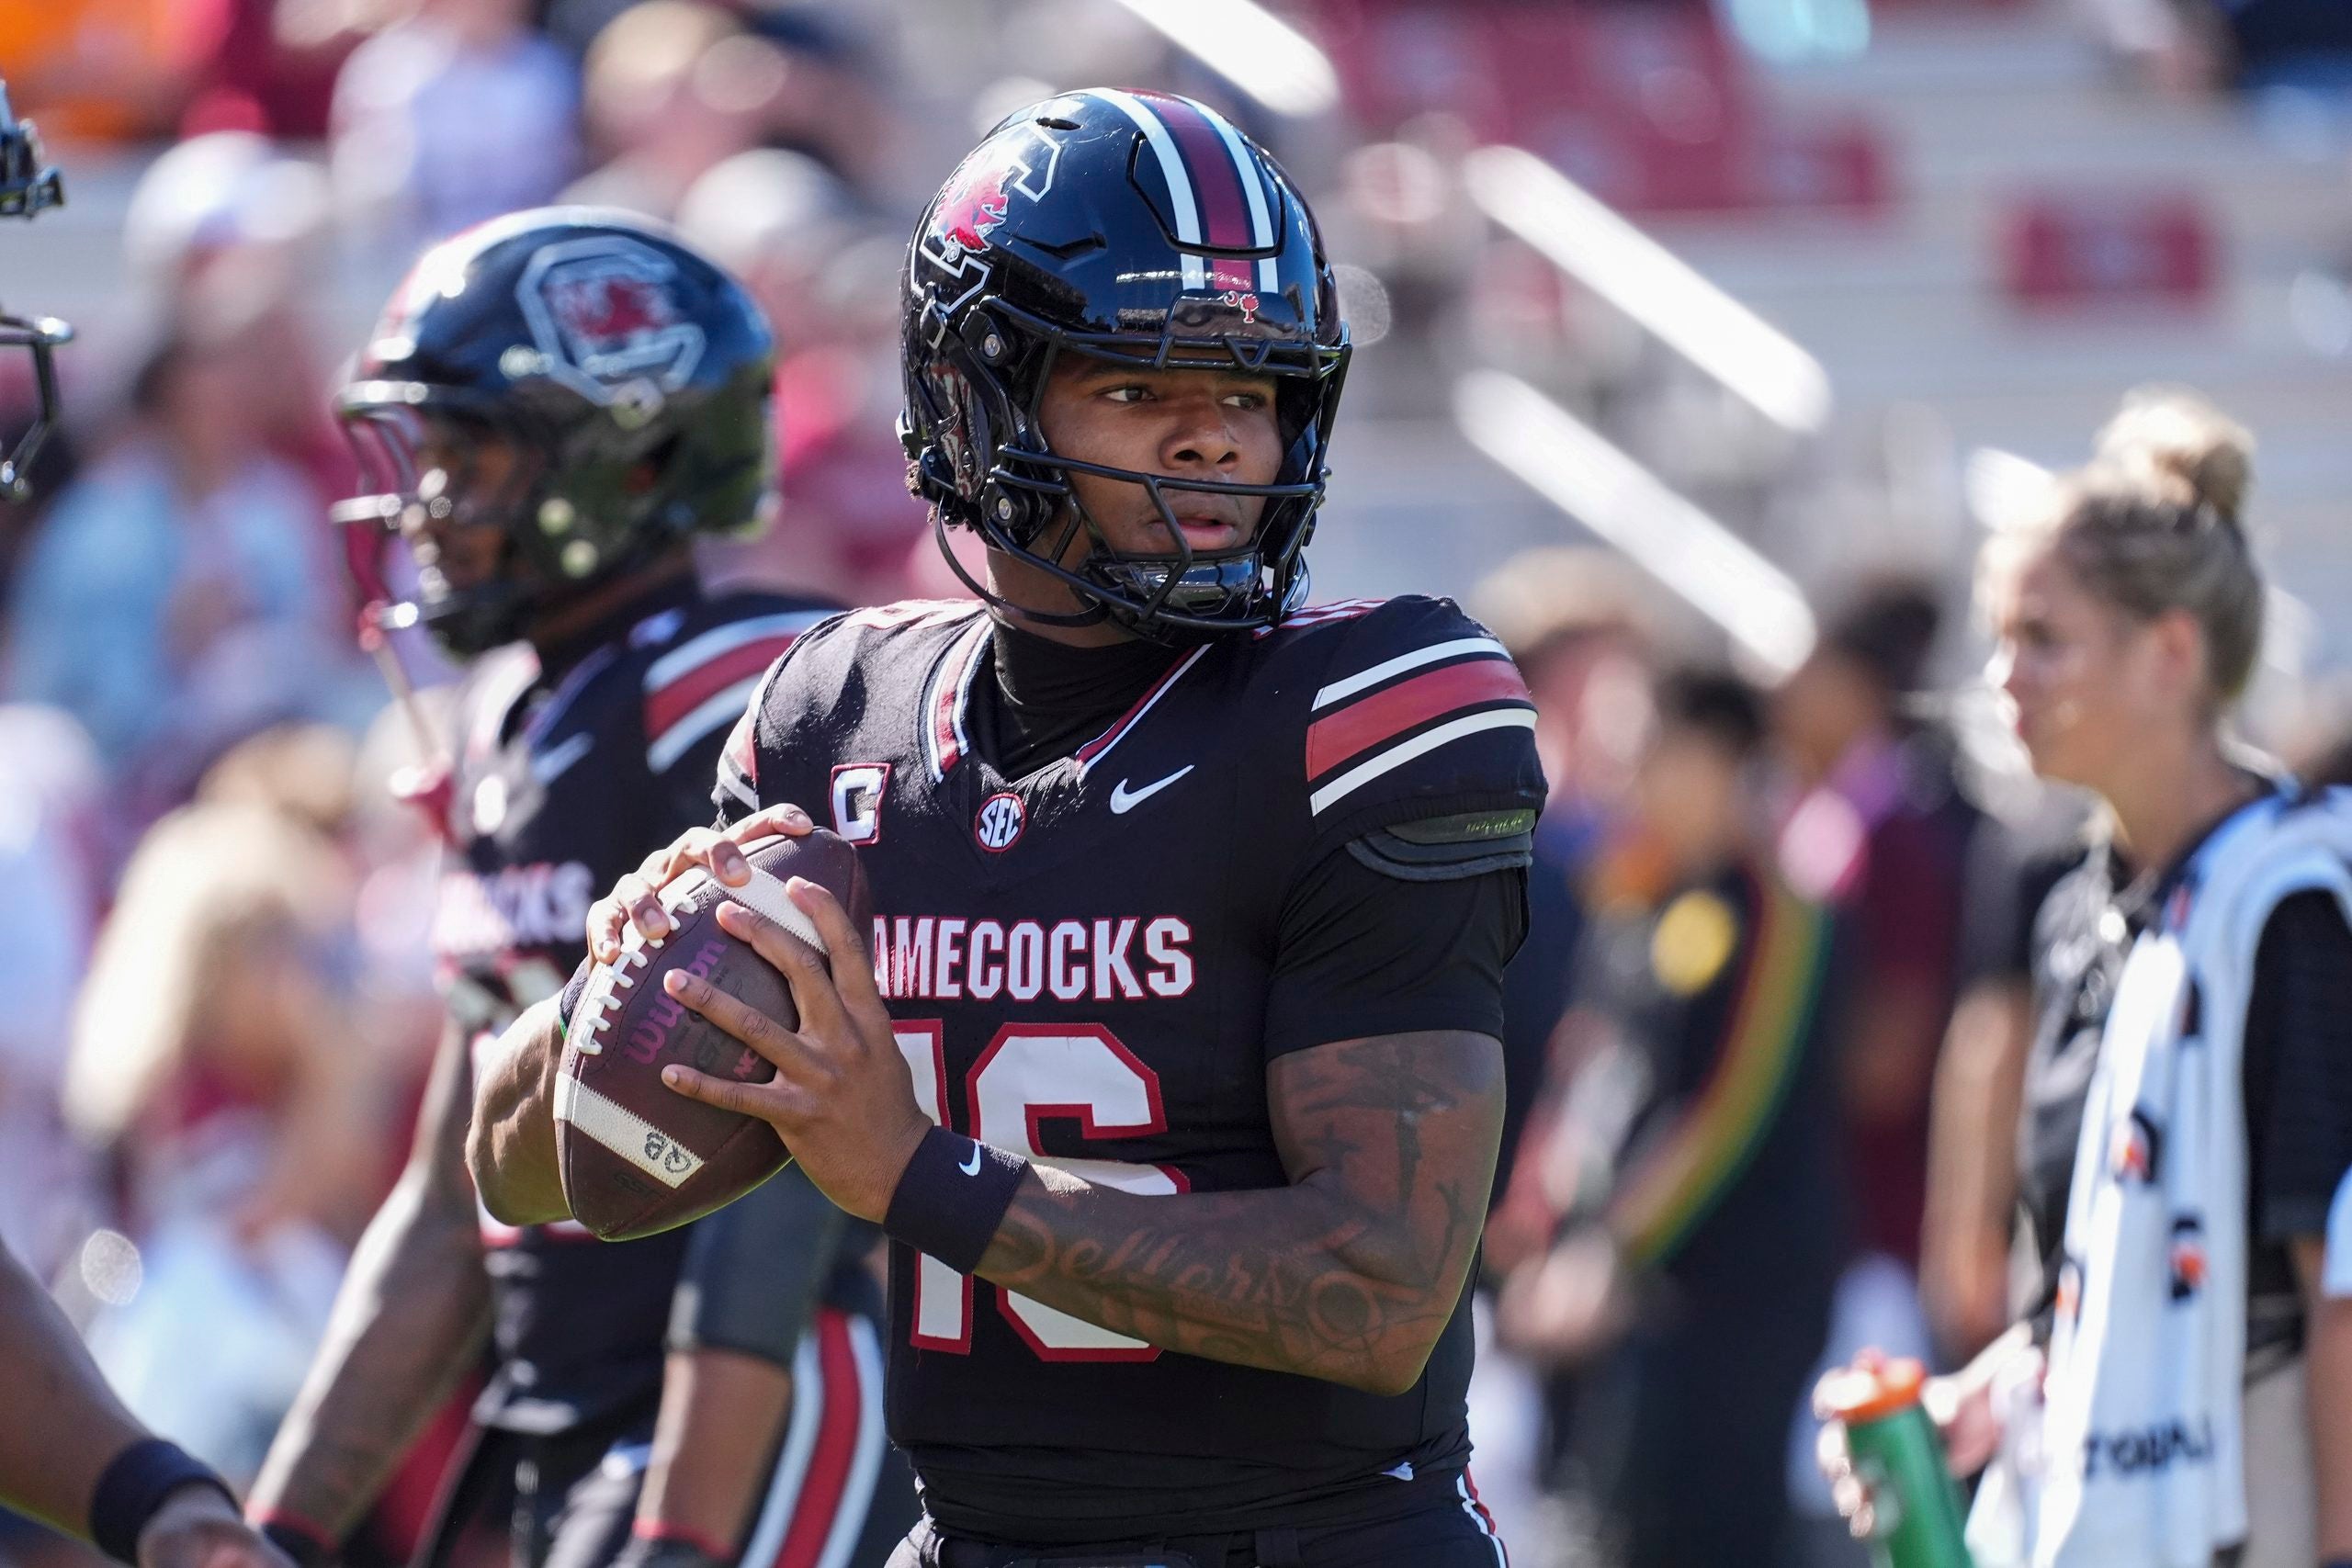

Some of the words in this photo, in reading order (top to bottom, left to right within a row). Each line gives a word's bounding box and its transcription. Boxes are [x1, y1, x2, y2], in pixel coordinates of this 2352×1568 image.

[832, 766, 885, 842] C
[978, 796, 1022, 849] SEC
[873, 916, 1195, 1001] AMECOCKS
[626, 940, 728, 1064] Wilon
[890, 1018, 1192, 1363] 16
